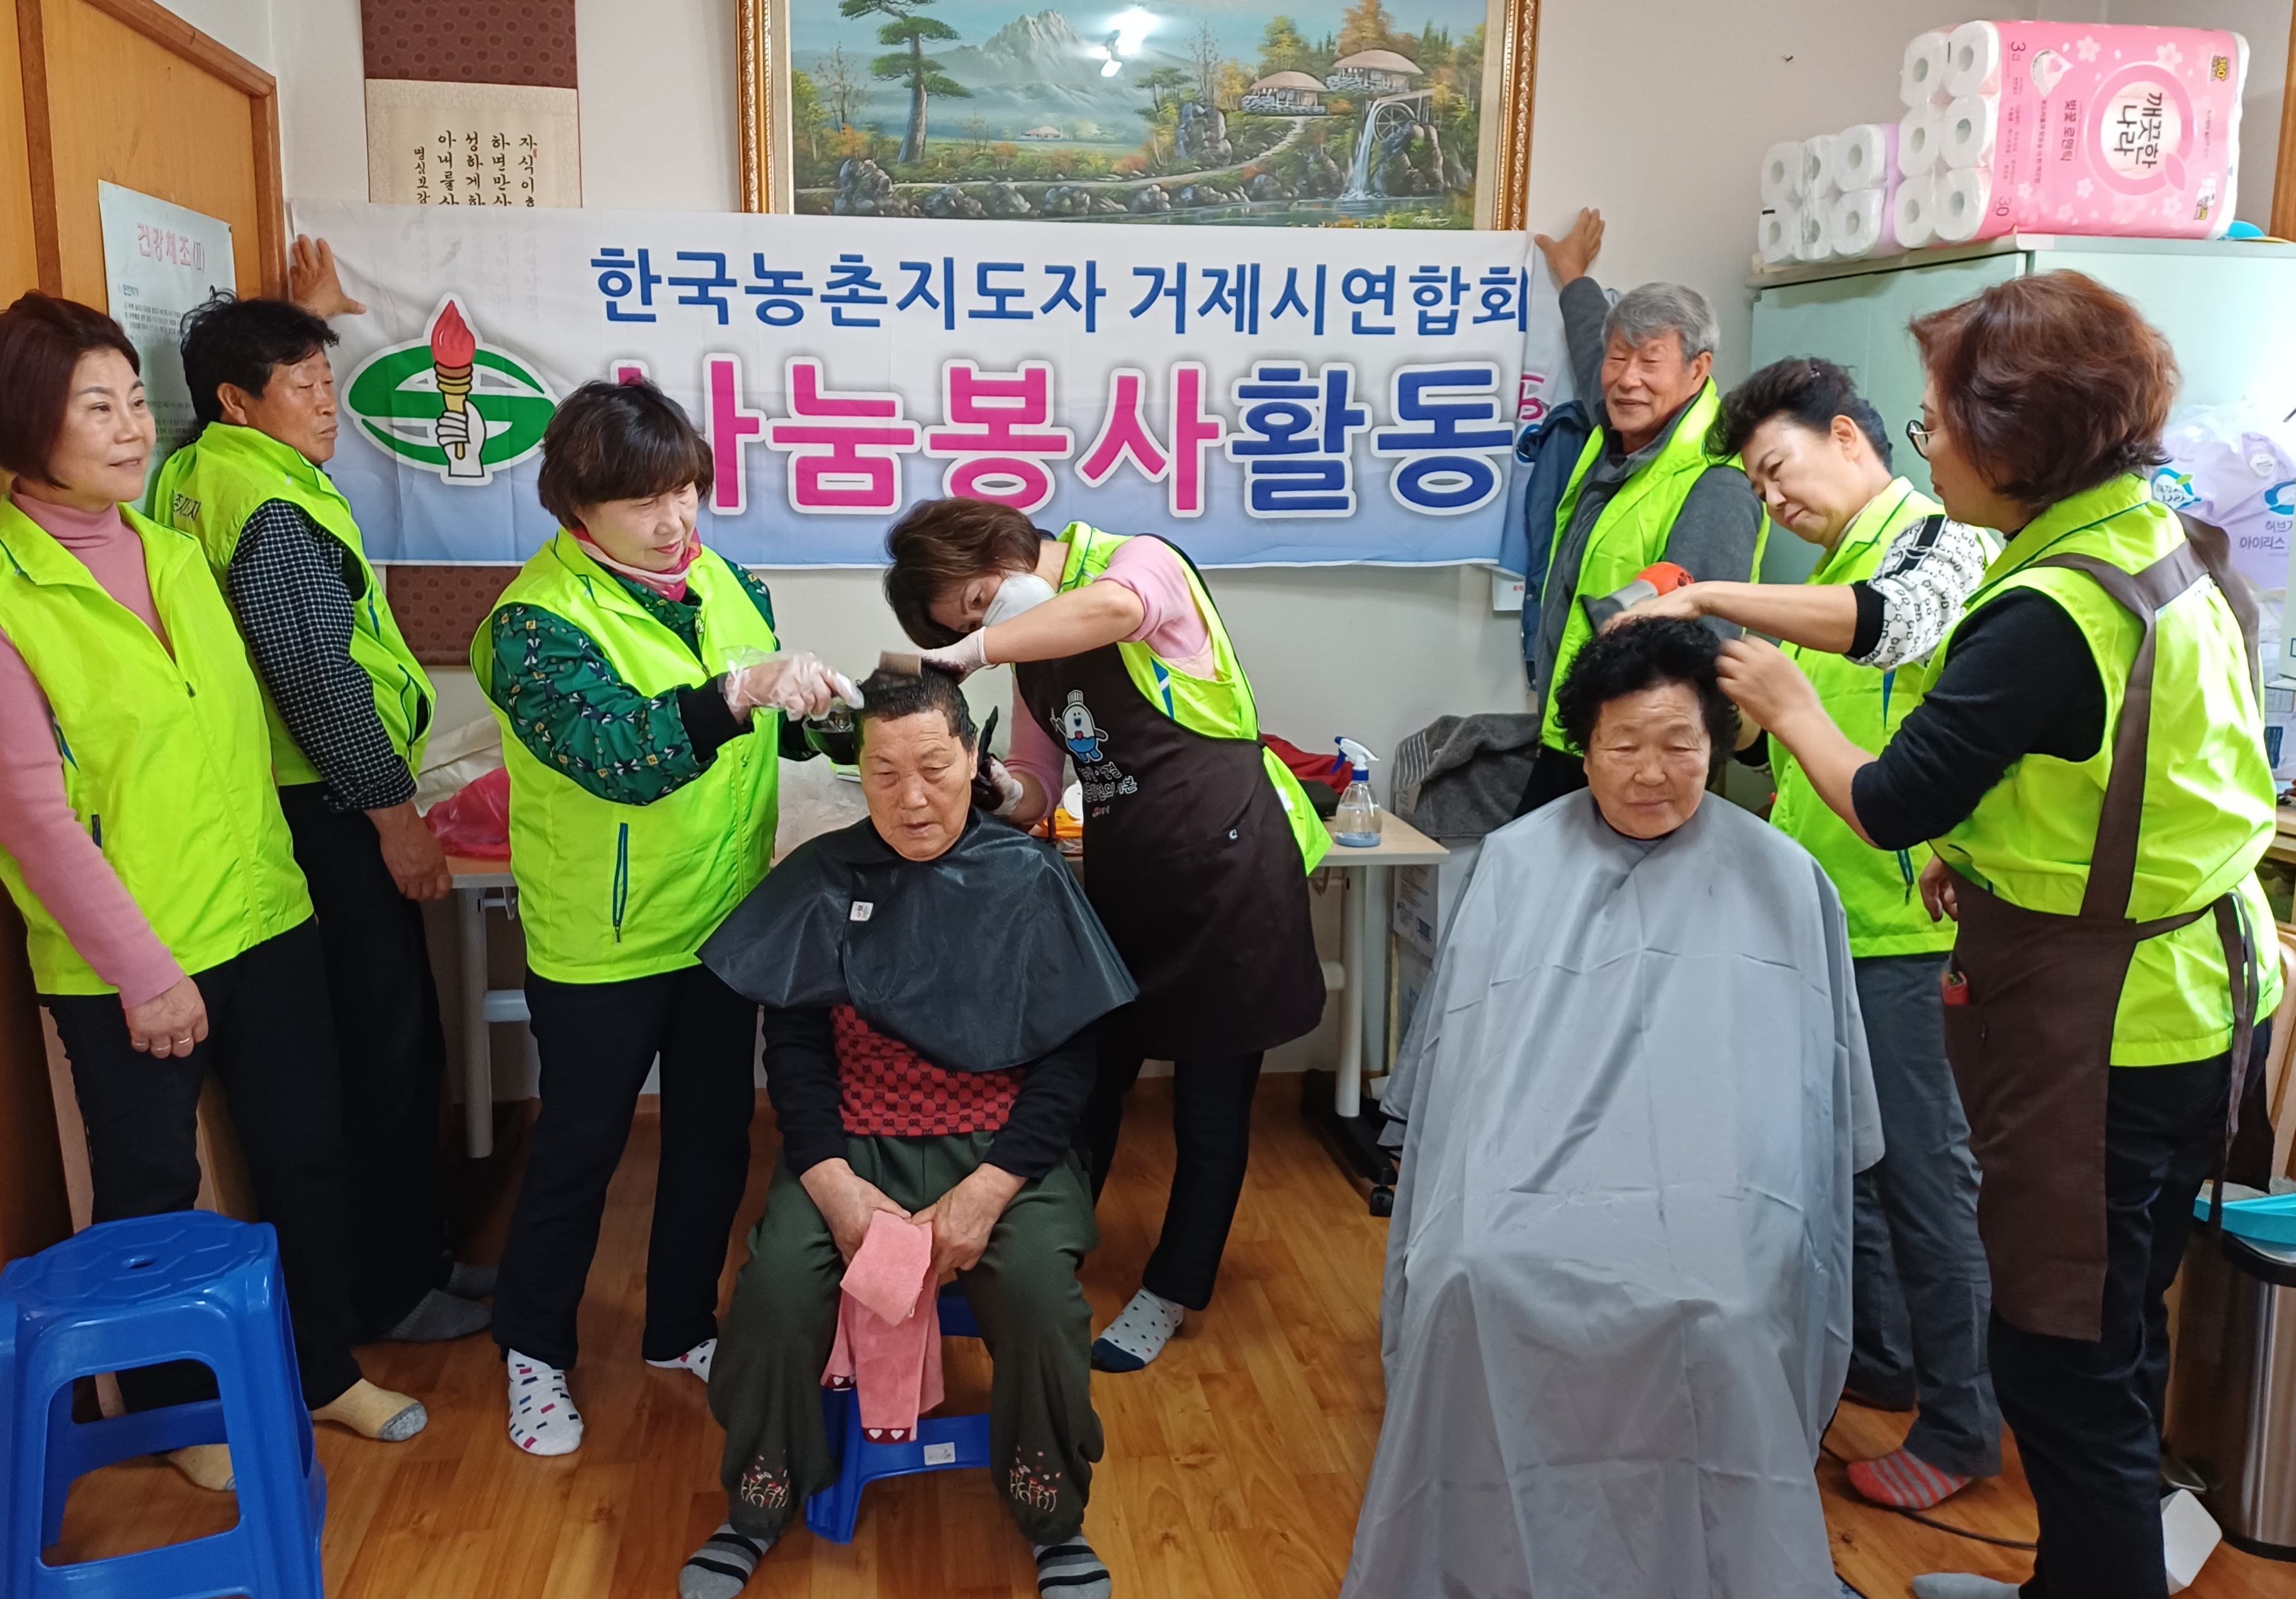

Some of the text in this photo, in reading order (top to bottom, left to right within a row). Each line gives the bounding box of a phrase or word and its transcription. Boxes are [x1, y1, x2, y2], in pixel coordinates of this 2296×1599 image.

[2060, 99, 2076, 161] 벚꽃 로맨틱
[2114, 105, 2137, 156] 나라
[2136, 92, 2163, 168] 깨끗한
[1996, 196, 2012, 217] 30
[590, 247, 1528, 336] 한국농촌지도자 거제시연합회
[2239, 536, 2285, 550] 아이리스
